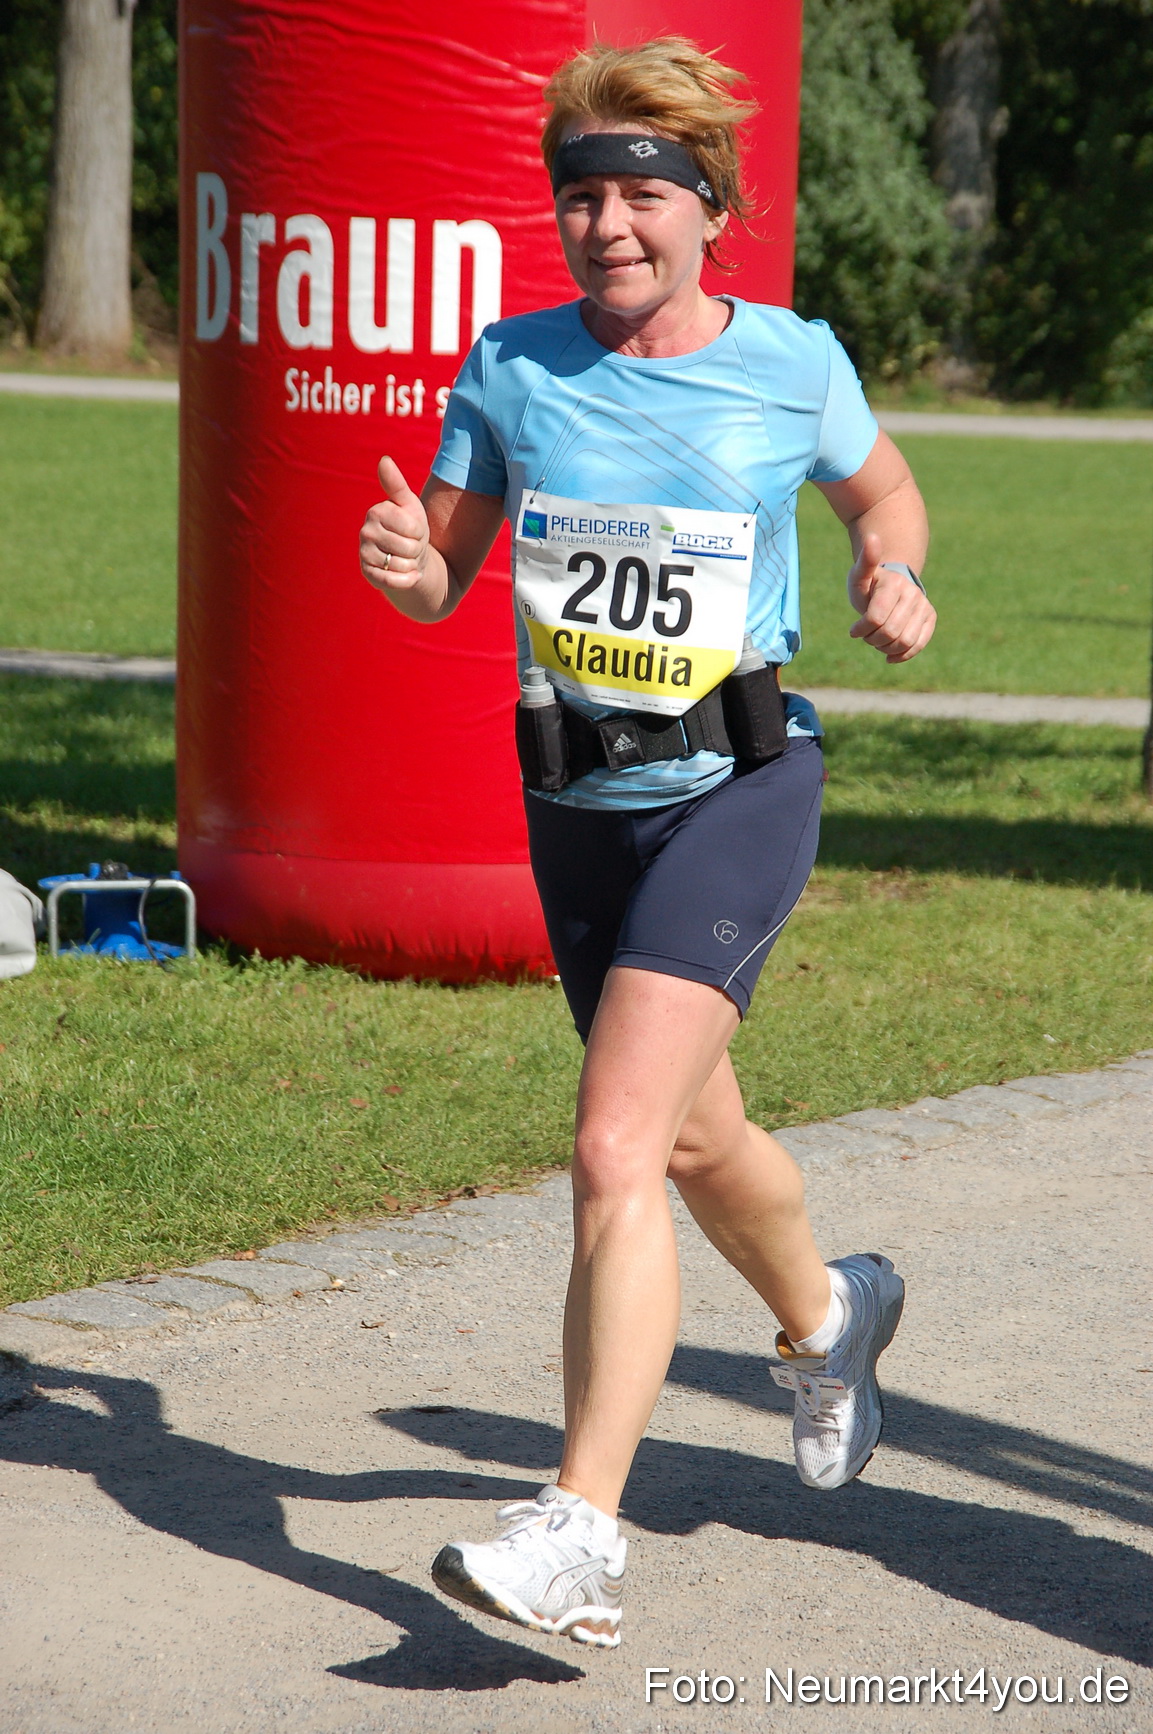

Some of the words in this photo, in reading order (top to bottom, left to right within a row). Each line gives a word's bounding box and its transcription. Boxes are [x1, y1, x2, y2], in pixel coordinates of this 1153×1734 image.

[196, 172, 503, 355] Braun
[285, 366, 375, 415] Sicher
[386, 374, 426, 416] ist
[550, 534, 650, 550] AKTIENGESELLSCHAFT
[551, 515, 650, 539] PFLEIDERER
[673, 533, 733, 550] BOCK
[560, 551, 695, 637] 205
[552, 629, 692, 687] Claudia
[612, 742, 637, 753] adidas
